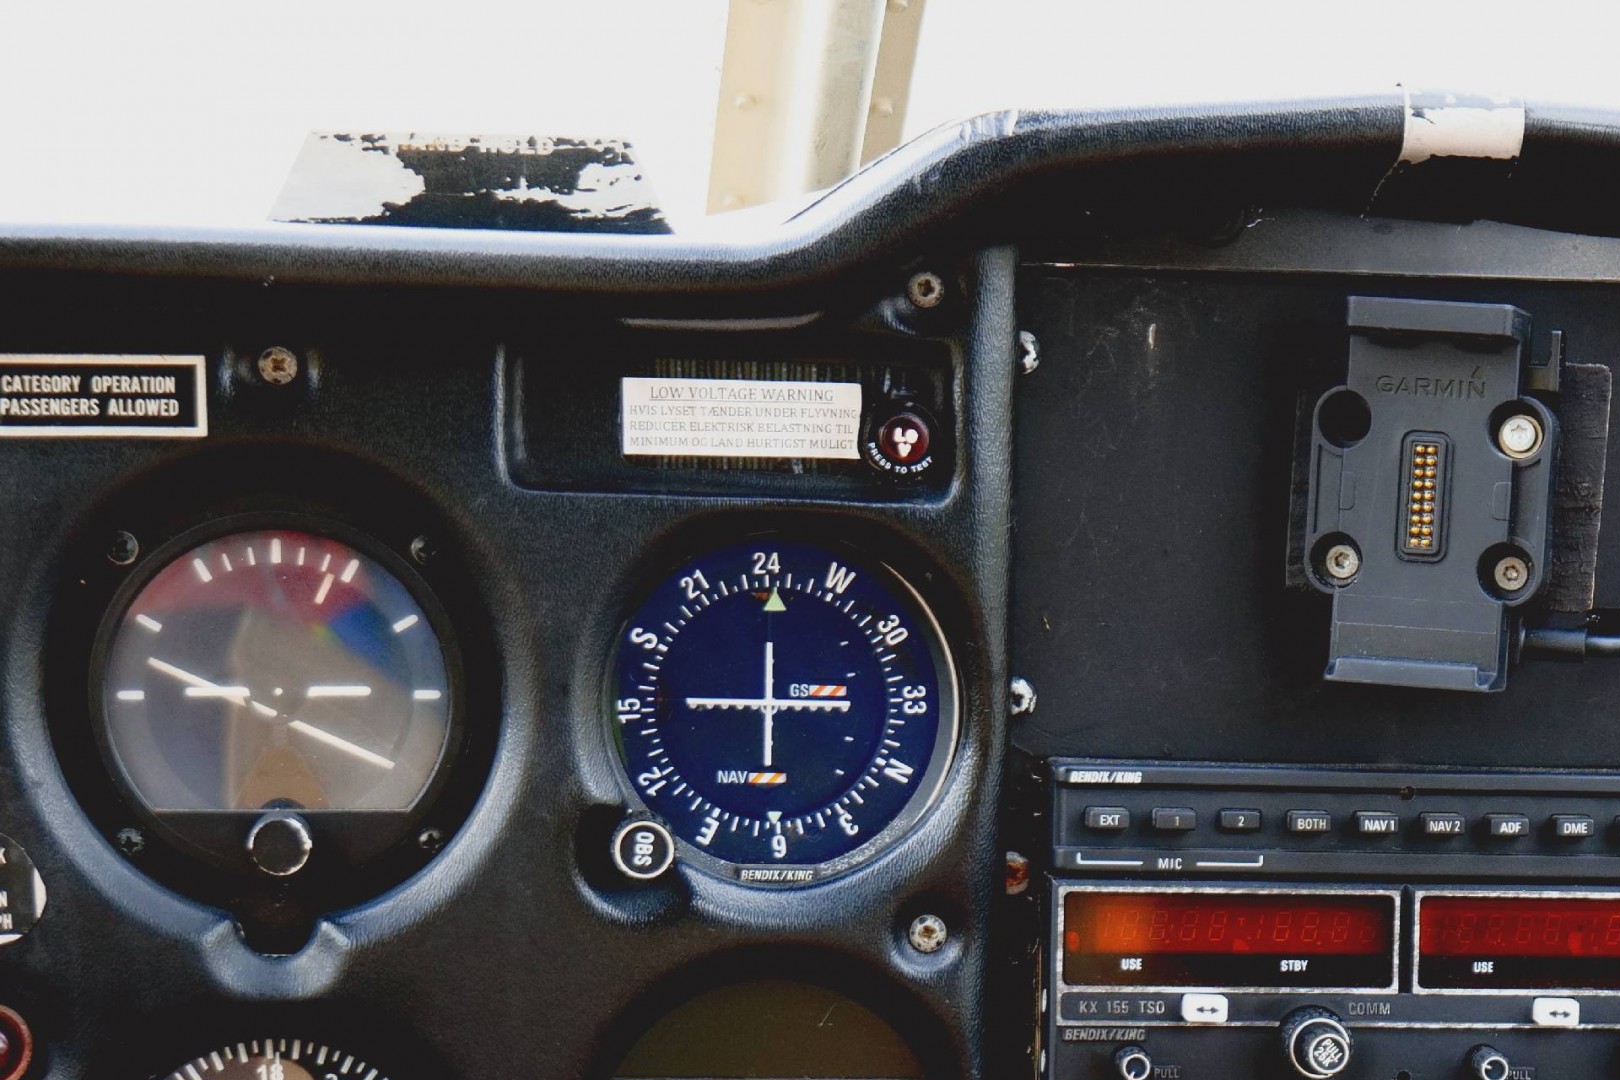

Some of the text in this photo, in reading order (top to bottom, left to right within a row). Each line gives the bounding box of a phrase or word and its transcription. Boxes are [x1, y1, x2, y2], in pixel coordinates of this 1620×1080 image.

[2, 375, 175, 394] CATEGORY OPERATION
[650, 387, 833, 401] LOW VOLTAGE WARNING
[108, 398, 179, 416] ALLOWED
[660, 407, 857, 419] LYSET UNDER FLYVNING
[753, 552, 780, 575] 24
[825, 562, 857, 594] W
[789, 683, 809, 697] GS
[718, 771, 748, 784] NAV
[1100, 815, 1120, 825] EXT
[1297, 819, 1326, 829] BOTH
[1365, 819, 1395, 831] NAV 1
[1430, 821, 1460, 832] NAV 2
[1500, 822, 1521, 833] ADF
[1564, 823, 1587, 833] DME
[1158, 858, 1183, 870] MIC
[740, 869, 814, 881] BENDIX/KING
[1121, 959, 1142, 970] USE
[1280, 960, 1308, 972] STBY
[1079, 1001, 1165, 1014] KX 155 TSO
